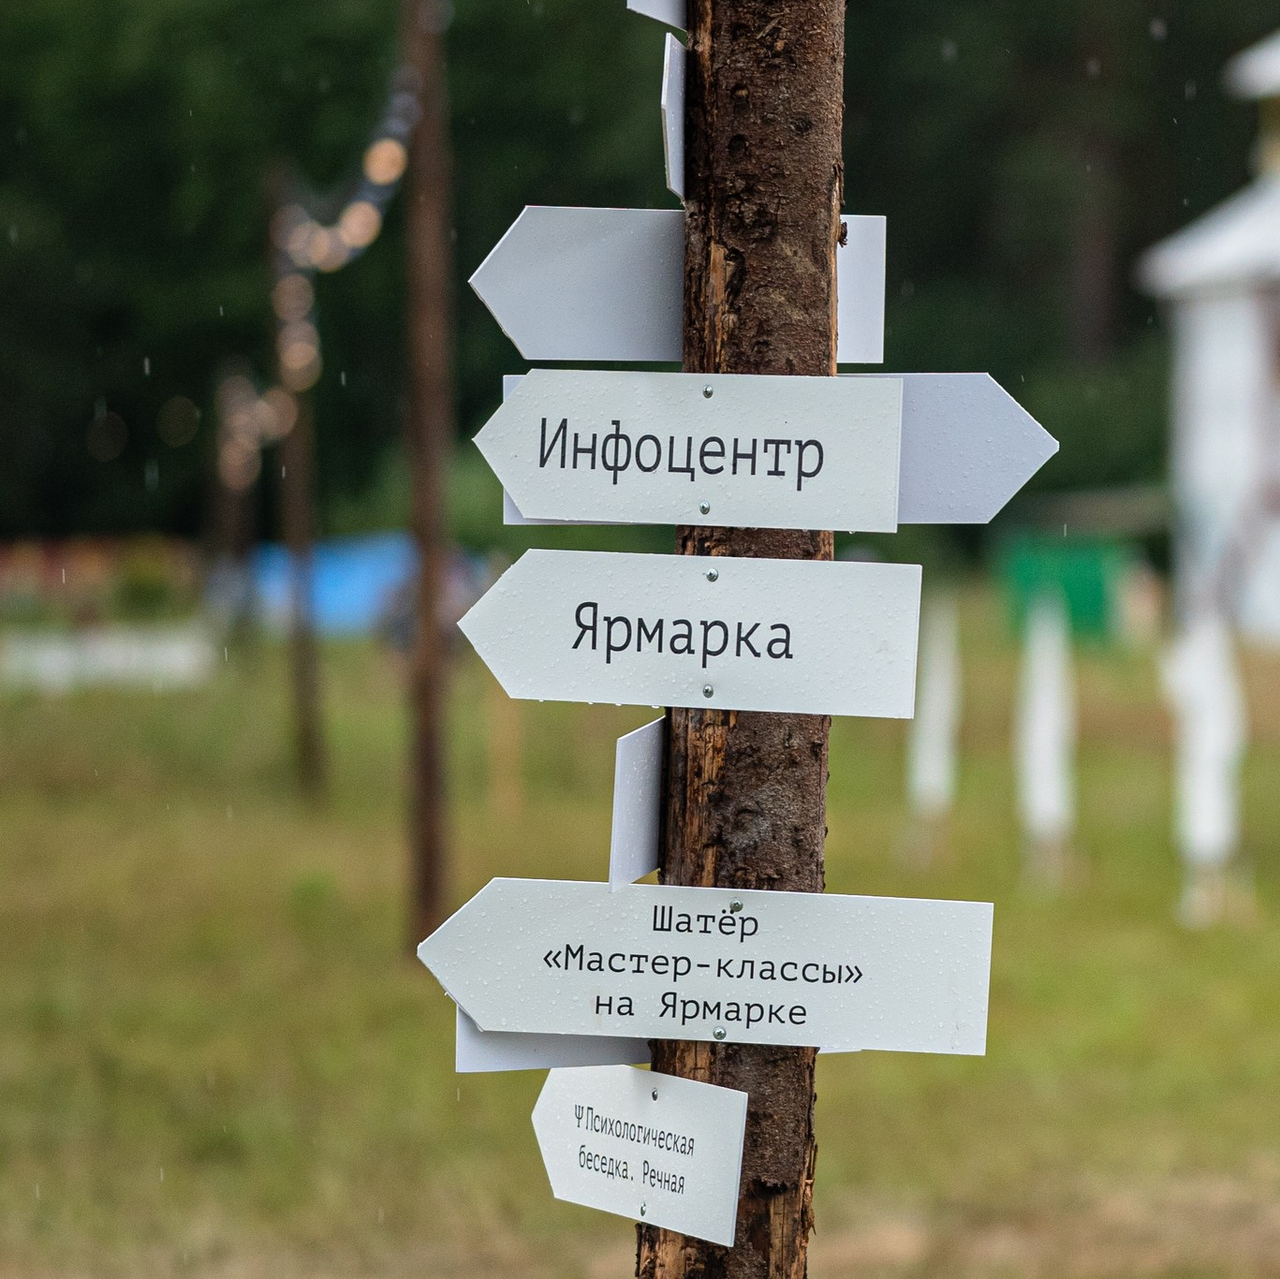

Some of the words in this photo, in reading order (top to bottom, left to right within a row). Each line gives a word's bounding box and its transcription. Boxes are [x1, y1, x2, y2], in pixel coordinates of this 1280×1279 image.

[539, 417, 824, 492] Инфоцентр
[571, 601, 794, 669] Ярмарка
[652, 904, 759, 943] Шатёр
[542, 943, 863, 984] «Мастер-классы»
[595, 995, 635, 1017] на
[658, 991, 807, 1030] Ярмарке
[578, 1144, 634, 1181] беседка.
[642, 1159, 685, 1195] Речная
